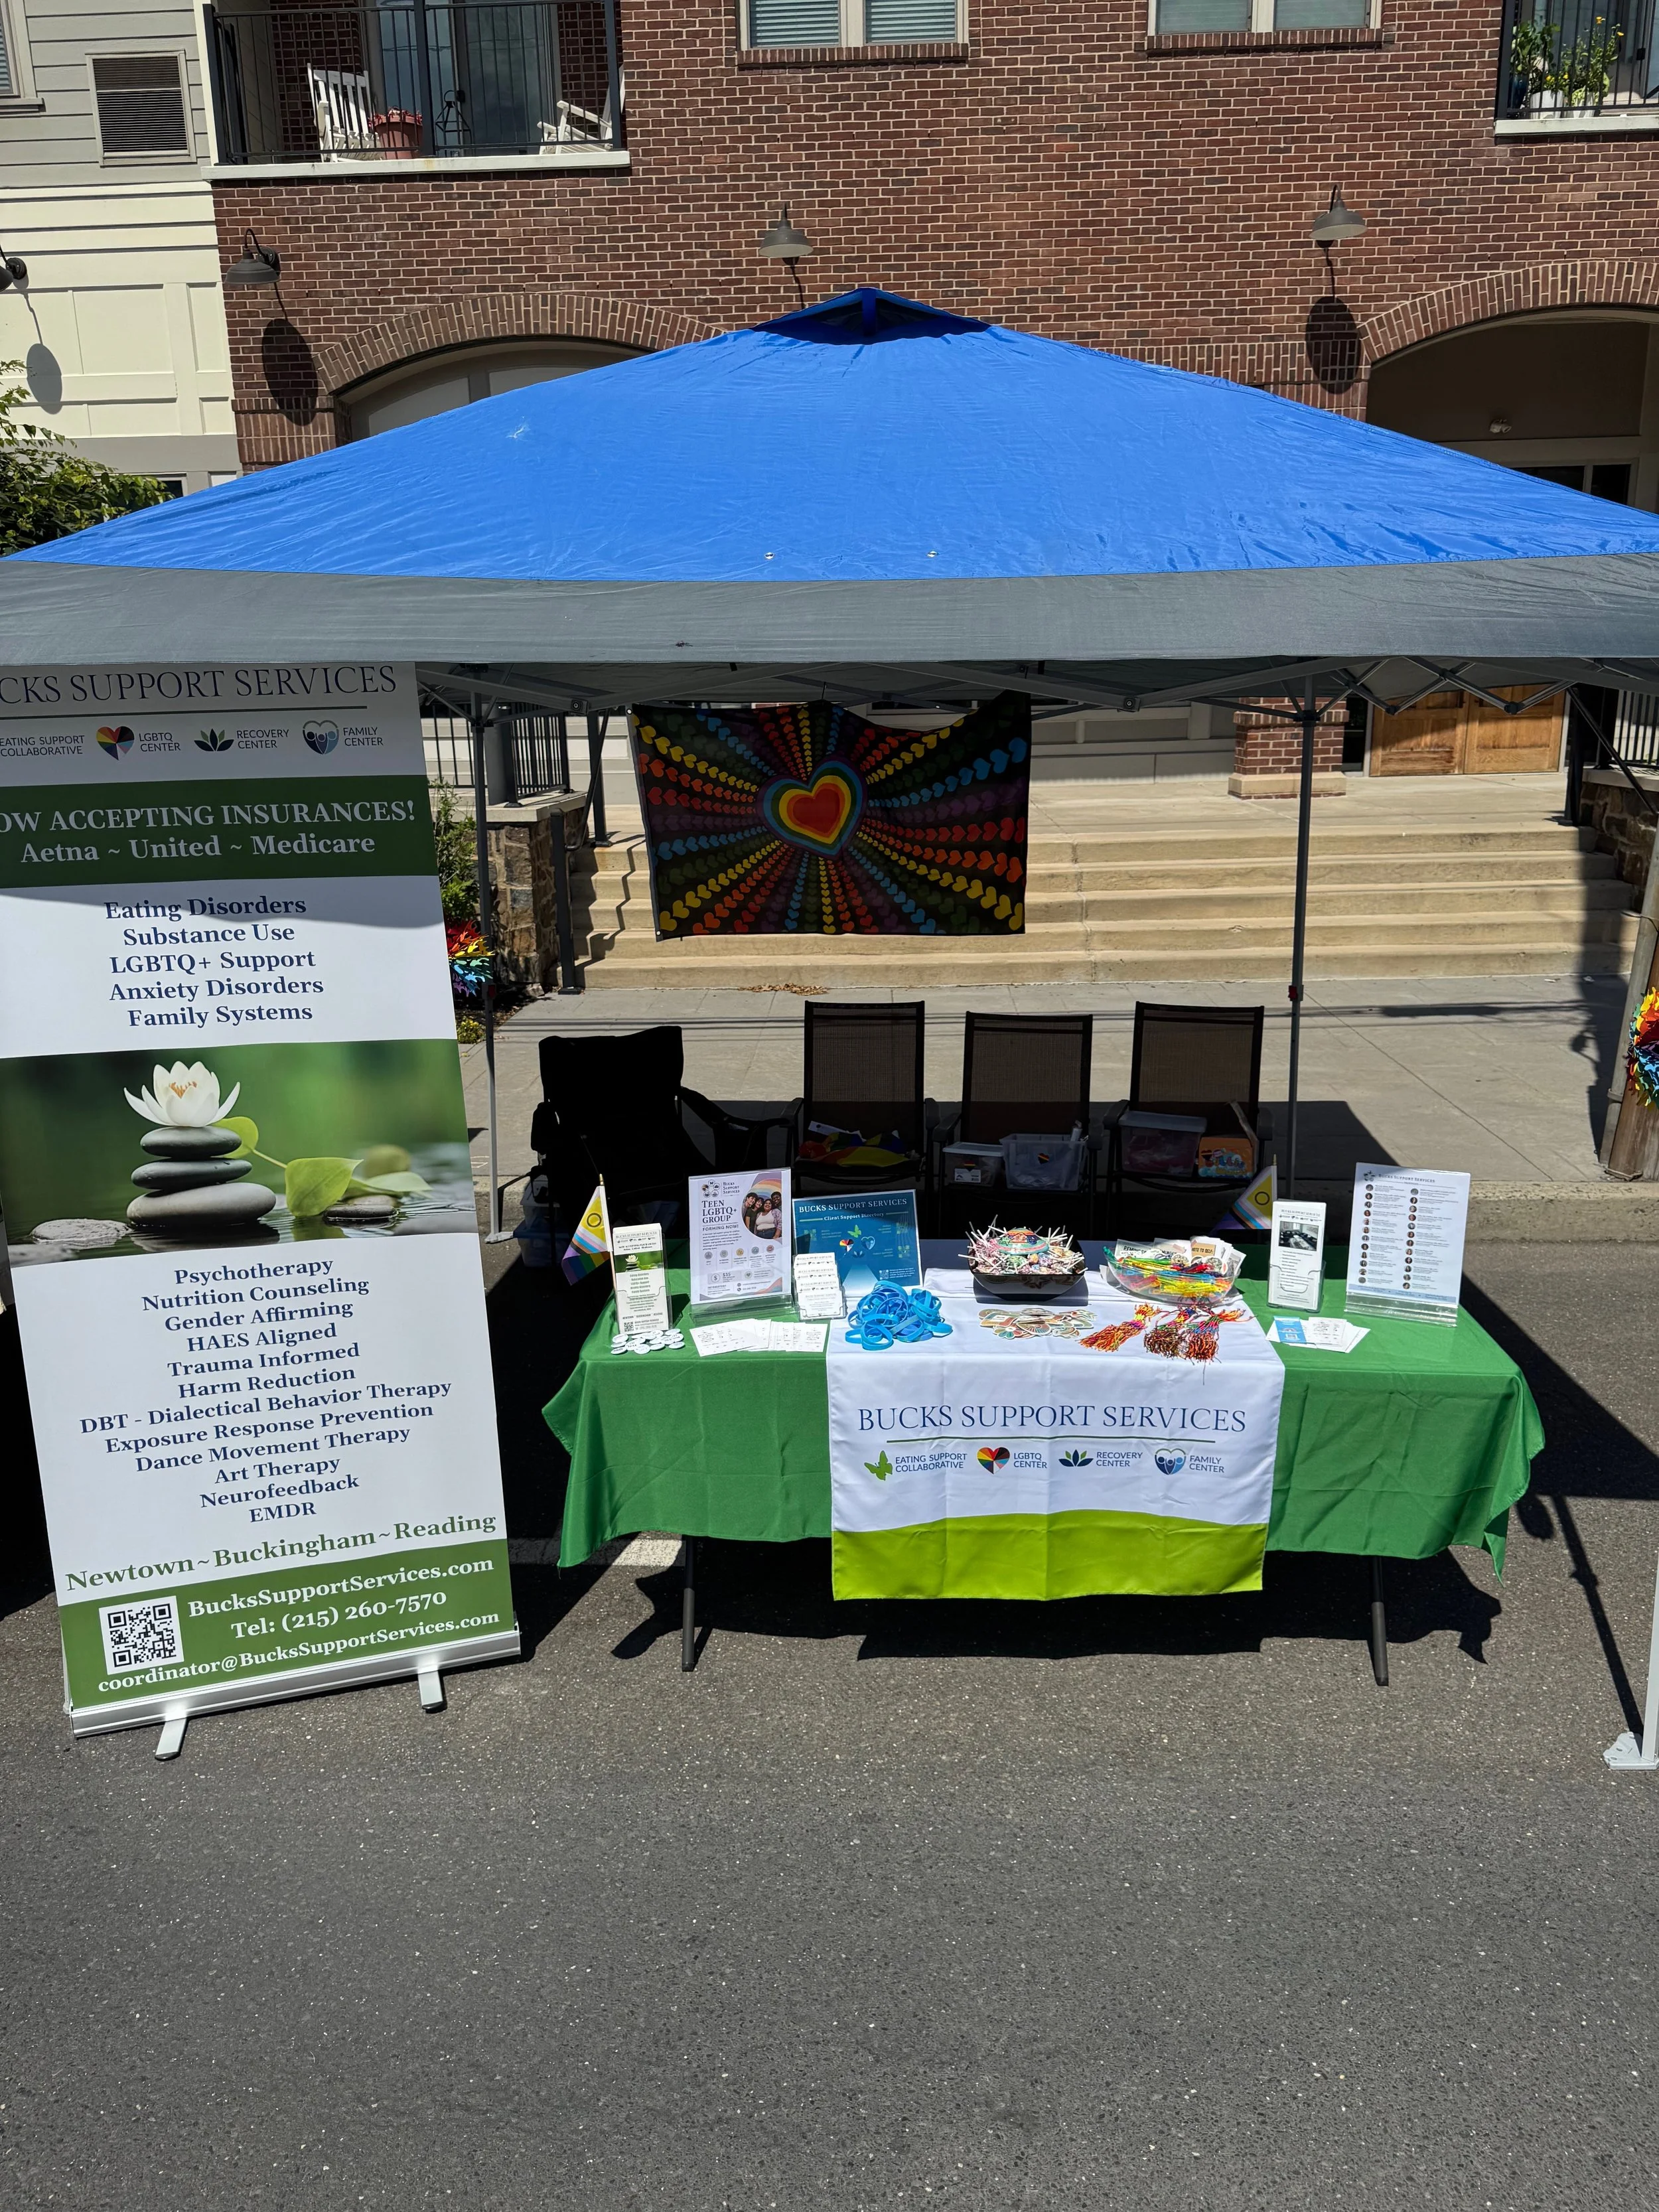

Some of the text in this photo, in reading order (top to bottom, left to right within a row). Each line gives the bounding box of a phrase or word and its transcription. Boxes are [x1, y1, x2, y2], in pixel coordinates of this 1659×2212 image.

[0, 666, 396, 703] CKS SUPPORT SERVICES
[0, 735, 84, 746] EATING SUPPORT
[139, 733, 173, 742] LGBTQ
[237, 729, 289, 739] RECOVERY
[343, 727, 377, 736] FAMILY
[344, 737, 383, 746] CENTER
[1, 746, 82, 757] COLLABORATIVE
[141, 743, 180, 752] CENTER
[238, 740, 277, 749] CENTER
[0, 800, 414, 832] OW ACCEPTING INSURANCES!
[21, 844, 100, 862] Aetna
[129, 836, 222, 858] United
[250, 833, 374, 854] Medicare
[104, 896, 306, 922] Eating Disorders
[124, 924, 294, 945] Substance Use
[109, 952, 316, 975] LGBTQ+ Support
[109, 976, 323, 1002] Anxiety Disorders
[127, 1005, 313, 1028] Family Systems
[702, 1207, 738, 1217] LGBTQ+
[828, 1201, 866, 1211] SUPPORT
[868, 1198, 908, 1207] SERVICES
[175, 1261, 333, 1286] Psychotherapy
[141, 1278, 369, 1310] Nutrition Counseling
[165, 1302, 353, 1331] Gender Affirming
[186, 1323, 336, 1351] HAES Aligned
[167, 1343, 360, 1376] Trauma Informed
[178, 1368, 356, 1398] Harm Reduction
[80, 1414, 128, 1434] DBT
[148, 1398, 261, 1424] Dialectical
[267, 1389, 362, 1410] Behavior
[367, 1384, 451, 1398] Therapy
[859, 1406, 1245, 1432] BUCKS SUPPORT SERVICES
[105, 1404, 433, 1453] Exposure Response Prevention
[135, 1430, 410, 1471] Dance Movement Therapy
[896, 1453, 967, 1464] EATING SUPPORT
[1190, 1455, 1221, 1464] FAMILY
[215, 1459, 340, 1483] Art Therapy
[896, 1461, 964, 1472] COLLABORATIVE
[1189, 1463, 1224, 1473] CENTER
[200, 1474, 359, 1507] Neurofeedback
[249, 1503, 317, 1522] EMDR
[188, 1558, 494, 1617] BucksSupportServices.com
[231, 1592, 446, 1638] Tel: (215) 260-7570
[99, 1614, 499, 1692] coordinator@BucksSupportServices.com
